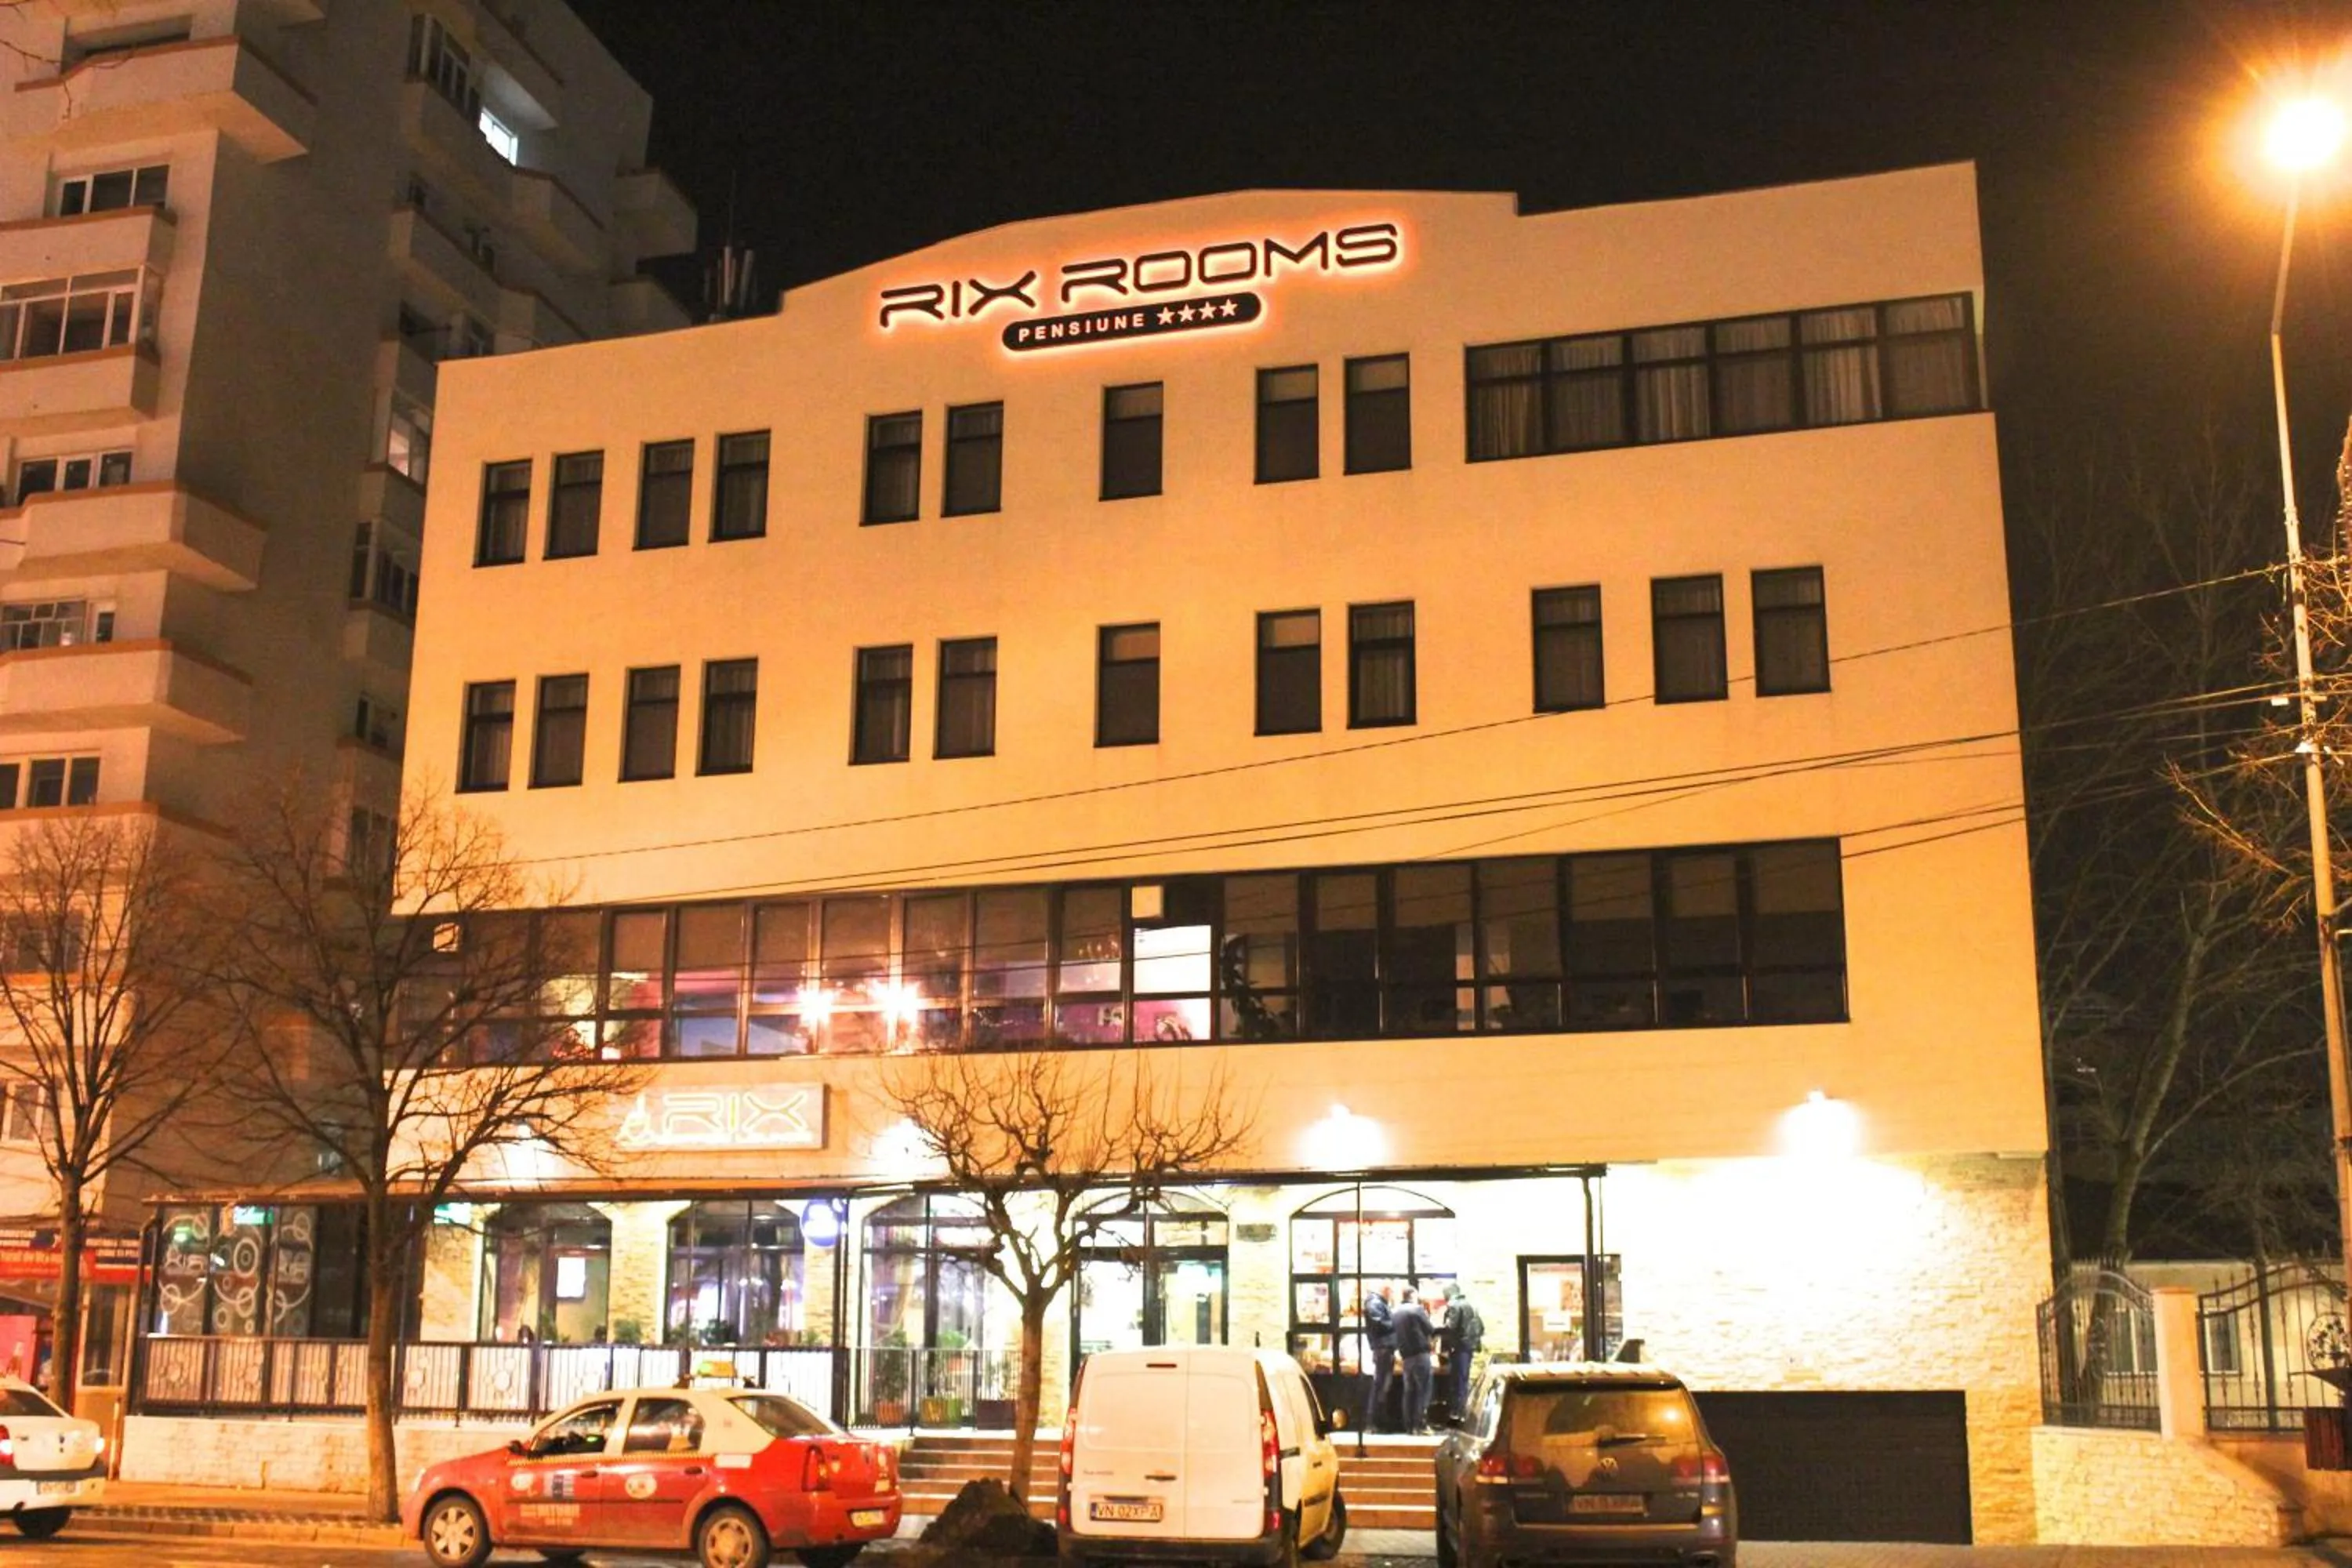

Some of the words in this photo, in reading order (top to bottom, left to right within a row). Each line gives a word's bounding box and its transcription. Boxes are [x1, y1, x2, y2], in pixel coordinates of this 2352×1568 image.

[879, 270, 1038, 328] RIX
[1061, 223, 1399, 303] ROOMS
[1018, 312, 1146, 343] PENSIUNE
[661, 1091, 809, 1134] RIX
